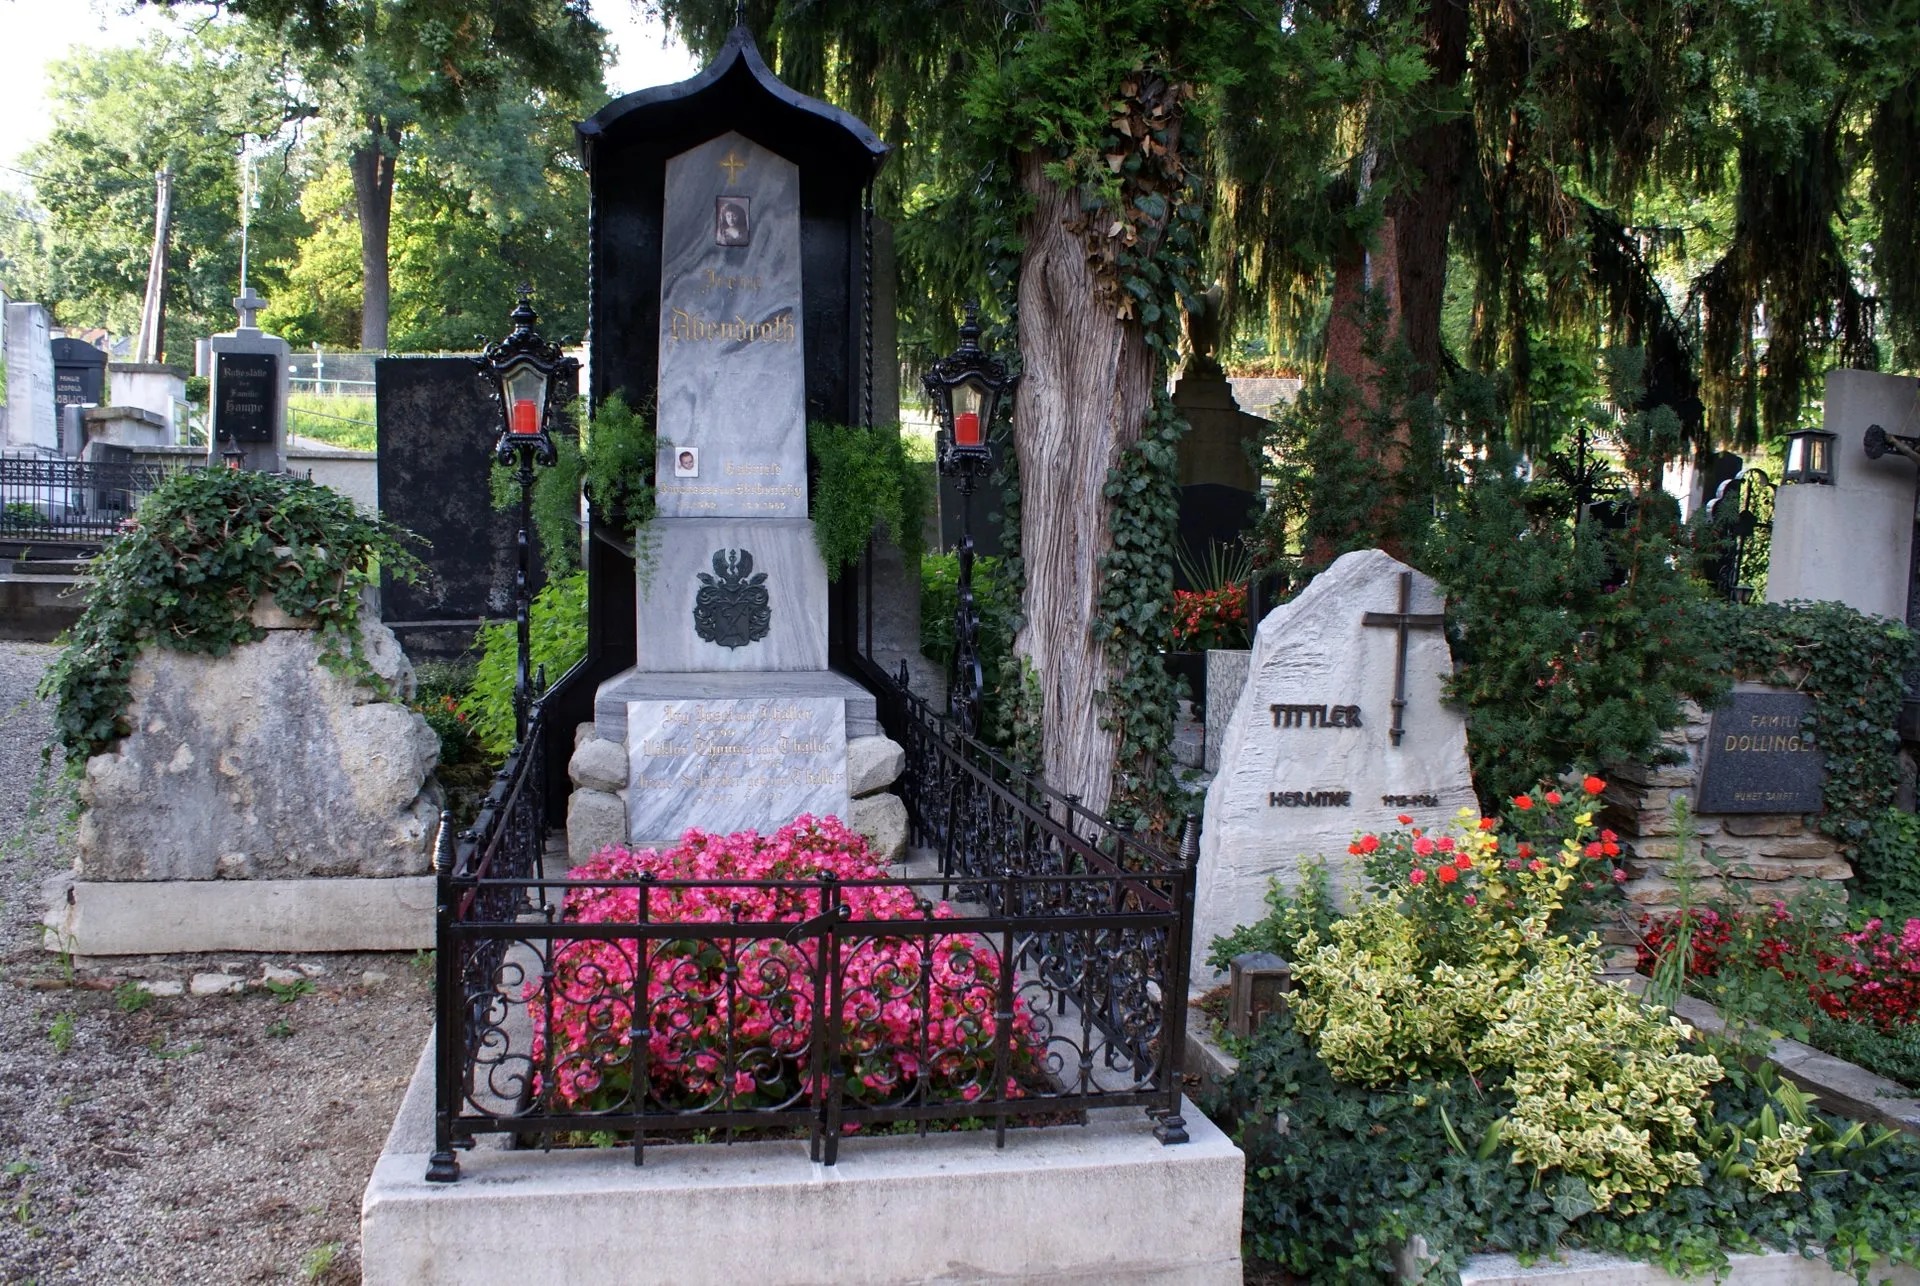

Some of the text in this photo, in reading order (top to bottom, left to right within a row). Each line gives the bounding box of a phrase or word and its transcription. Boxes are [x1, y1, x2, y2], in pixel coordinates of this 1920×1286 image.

[671, 306, 795, 342] Abendroth
[1750, 715, 1799, 728] FAMILI
[1725, 735, 1816, 752] DOLLINGE
[1269, 791, 1352, 808] HERMINE
